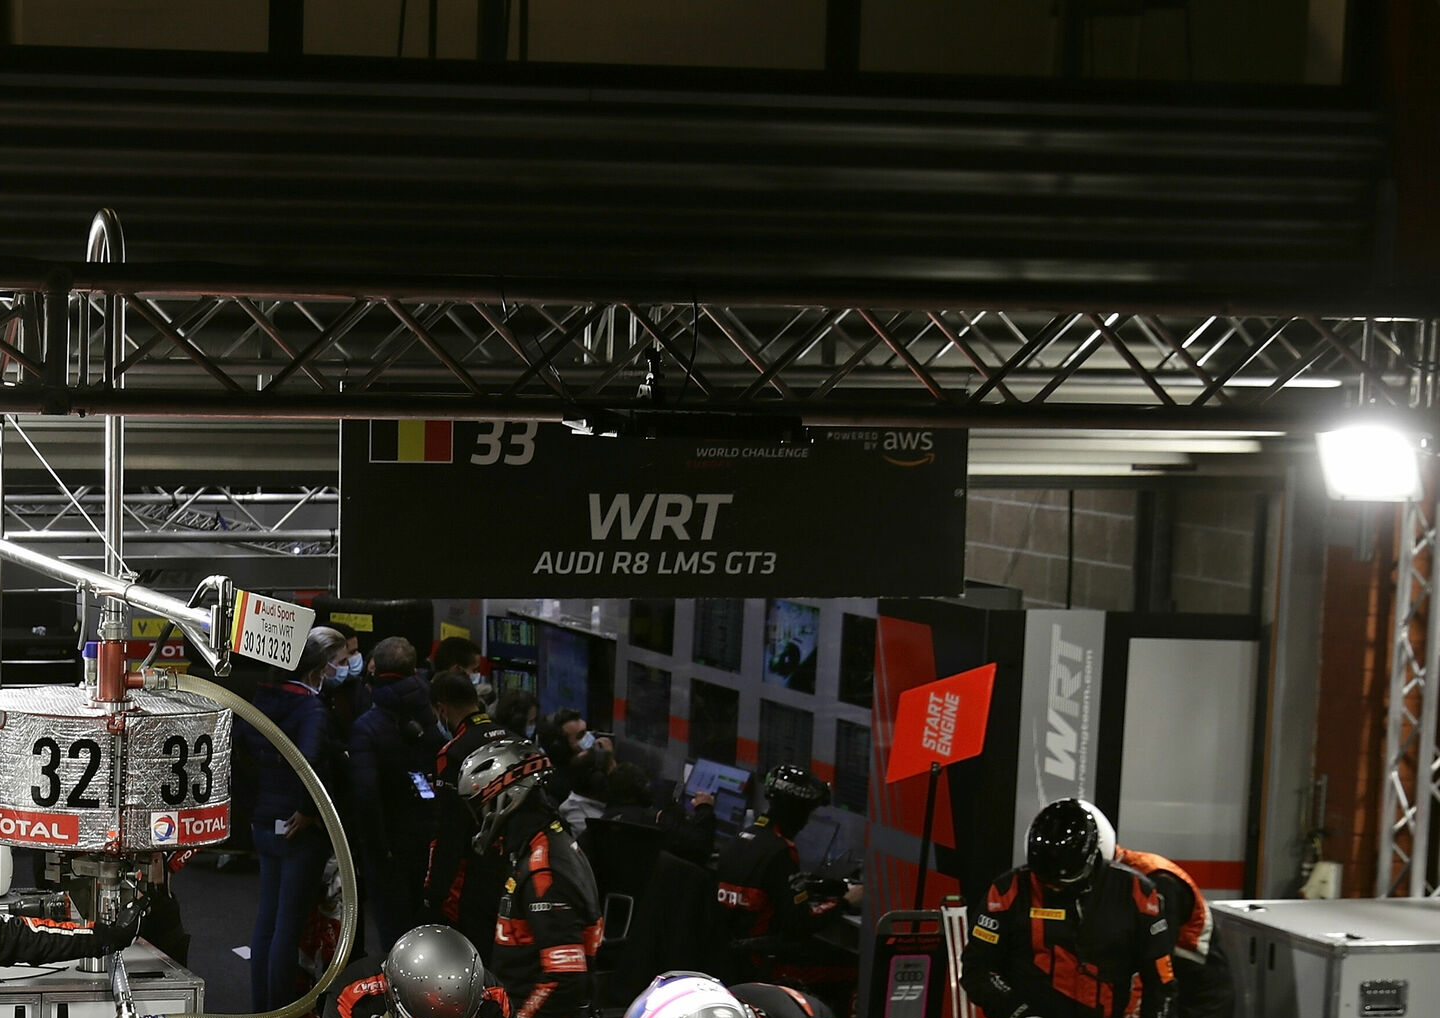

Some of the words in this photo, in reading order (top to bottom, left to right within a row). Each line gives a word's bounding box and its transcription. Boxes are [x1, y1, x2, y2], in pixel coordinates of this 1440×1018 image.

[470, 419, 537, 467] 33
[696, 447, 739, 458] WORLD
[742, 447, 809, 459] CHALLENGE
[826, 431, 879, 441] POWERED
[883, 431, 933, 451] aws
[863, 441, 877, 450] BY
[588, 492, 734, 541] WRT
[532, 550, 604, 575] AUDI
[612, 551, 649, 575] R8
[657, 551, 716, 575] LMS
[724, 551, 777, 575] GT3
[262, 604, 277, 618] Audi
[278, 606, 295, 622] Sport
[262, 619, 278, 634] Team
[279, 623, 294, 637] WRT
[244, 630, 255, 651] 30
[256, 636, 266, 656] 31
[268, 638, 280, 660] 32
[281, 642, 292, 664] 33
[1044, 624, 1083, 782] WRT
[922, 691, 943, 751] START
[936, 691, 961, 757] ENGINE
[31, 737, 102, 809] 32
[160, 733, 213, 806] 33
[181, 817, 227, 836] TOTAL
